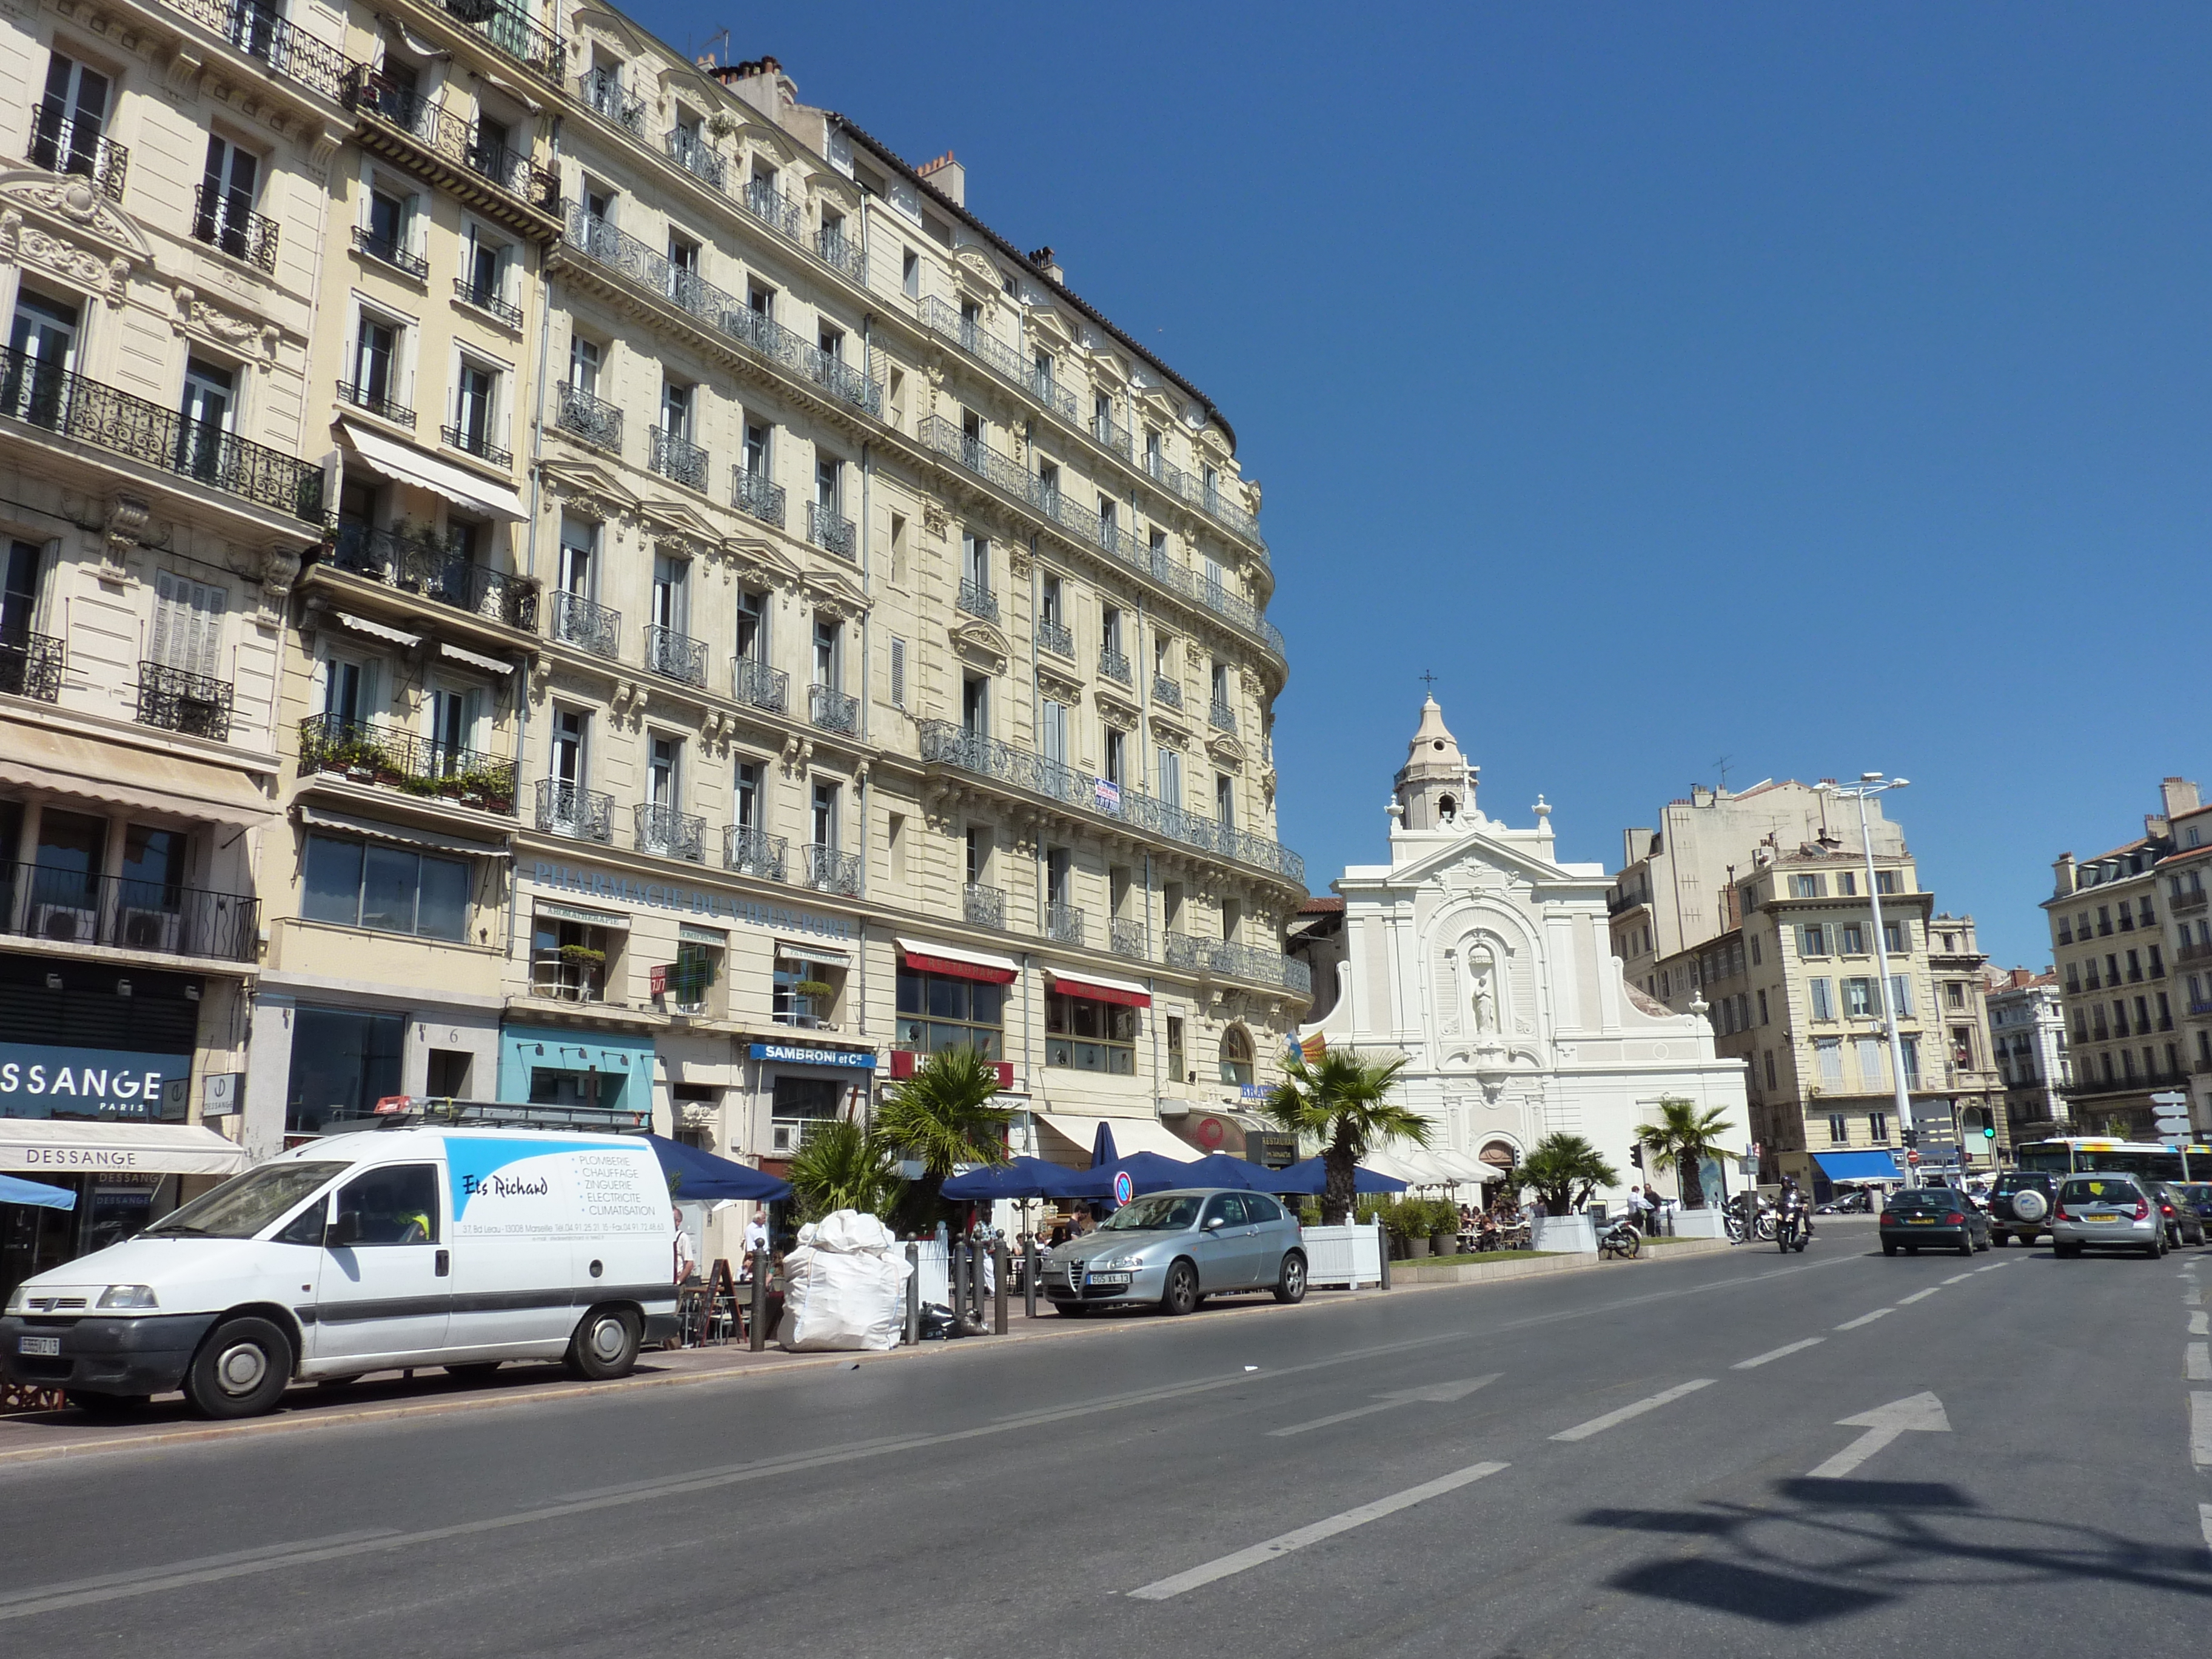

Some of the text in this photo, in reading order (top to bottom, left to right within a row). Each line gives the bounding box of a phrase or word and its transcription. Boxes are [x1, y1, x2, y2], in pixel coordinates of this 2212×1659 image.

[532, 862, 851, 942] PHARMACIE DU VIEUX PORT
[547, 907, 620, 925] AROMATHERAPIE
[927, 958, 1000, 979] RESTAURANT
[450, 1028, 458, 1043] 6
[766, 1046, 836, 1062] SAMBRONI
[99, 1102, 144, 1112] PARIS
[204, 1101, 233, 1110] DESSANGE
[1262, 1136, 1298, 1146] RESTAURANT
[27, 1149, 136, 1165] DESSANGE
[579, 1156, 631, 1166] PLOMBERIE
[582, 1168, 639, 1178] CHAUFFAGE
[463, 1174, 548, 1198] Ets Richard
[585, 1180, 632, 1190] ZINGUERIE
[588, 1193, 642, 1202] ELECTRICITE
[589, 1205, 655, 1216] CLIMATISATION
[474, 1225, 483, 1233] Bd
[504, 1224, 524, 1233] 13008
[525, 1224, 553, 1233] Marseille
[1121, 1274, 1128, 1282] 13
